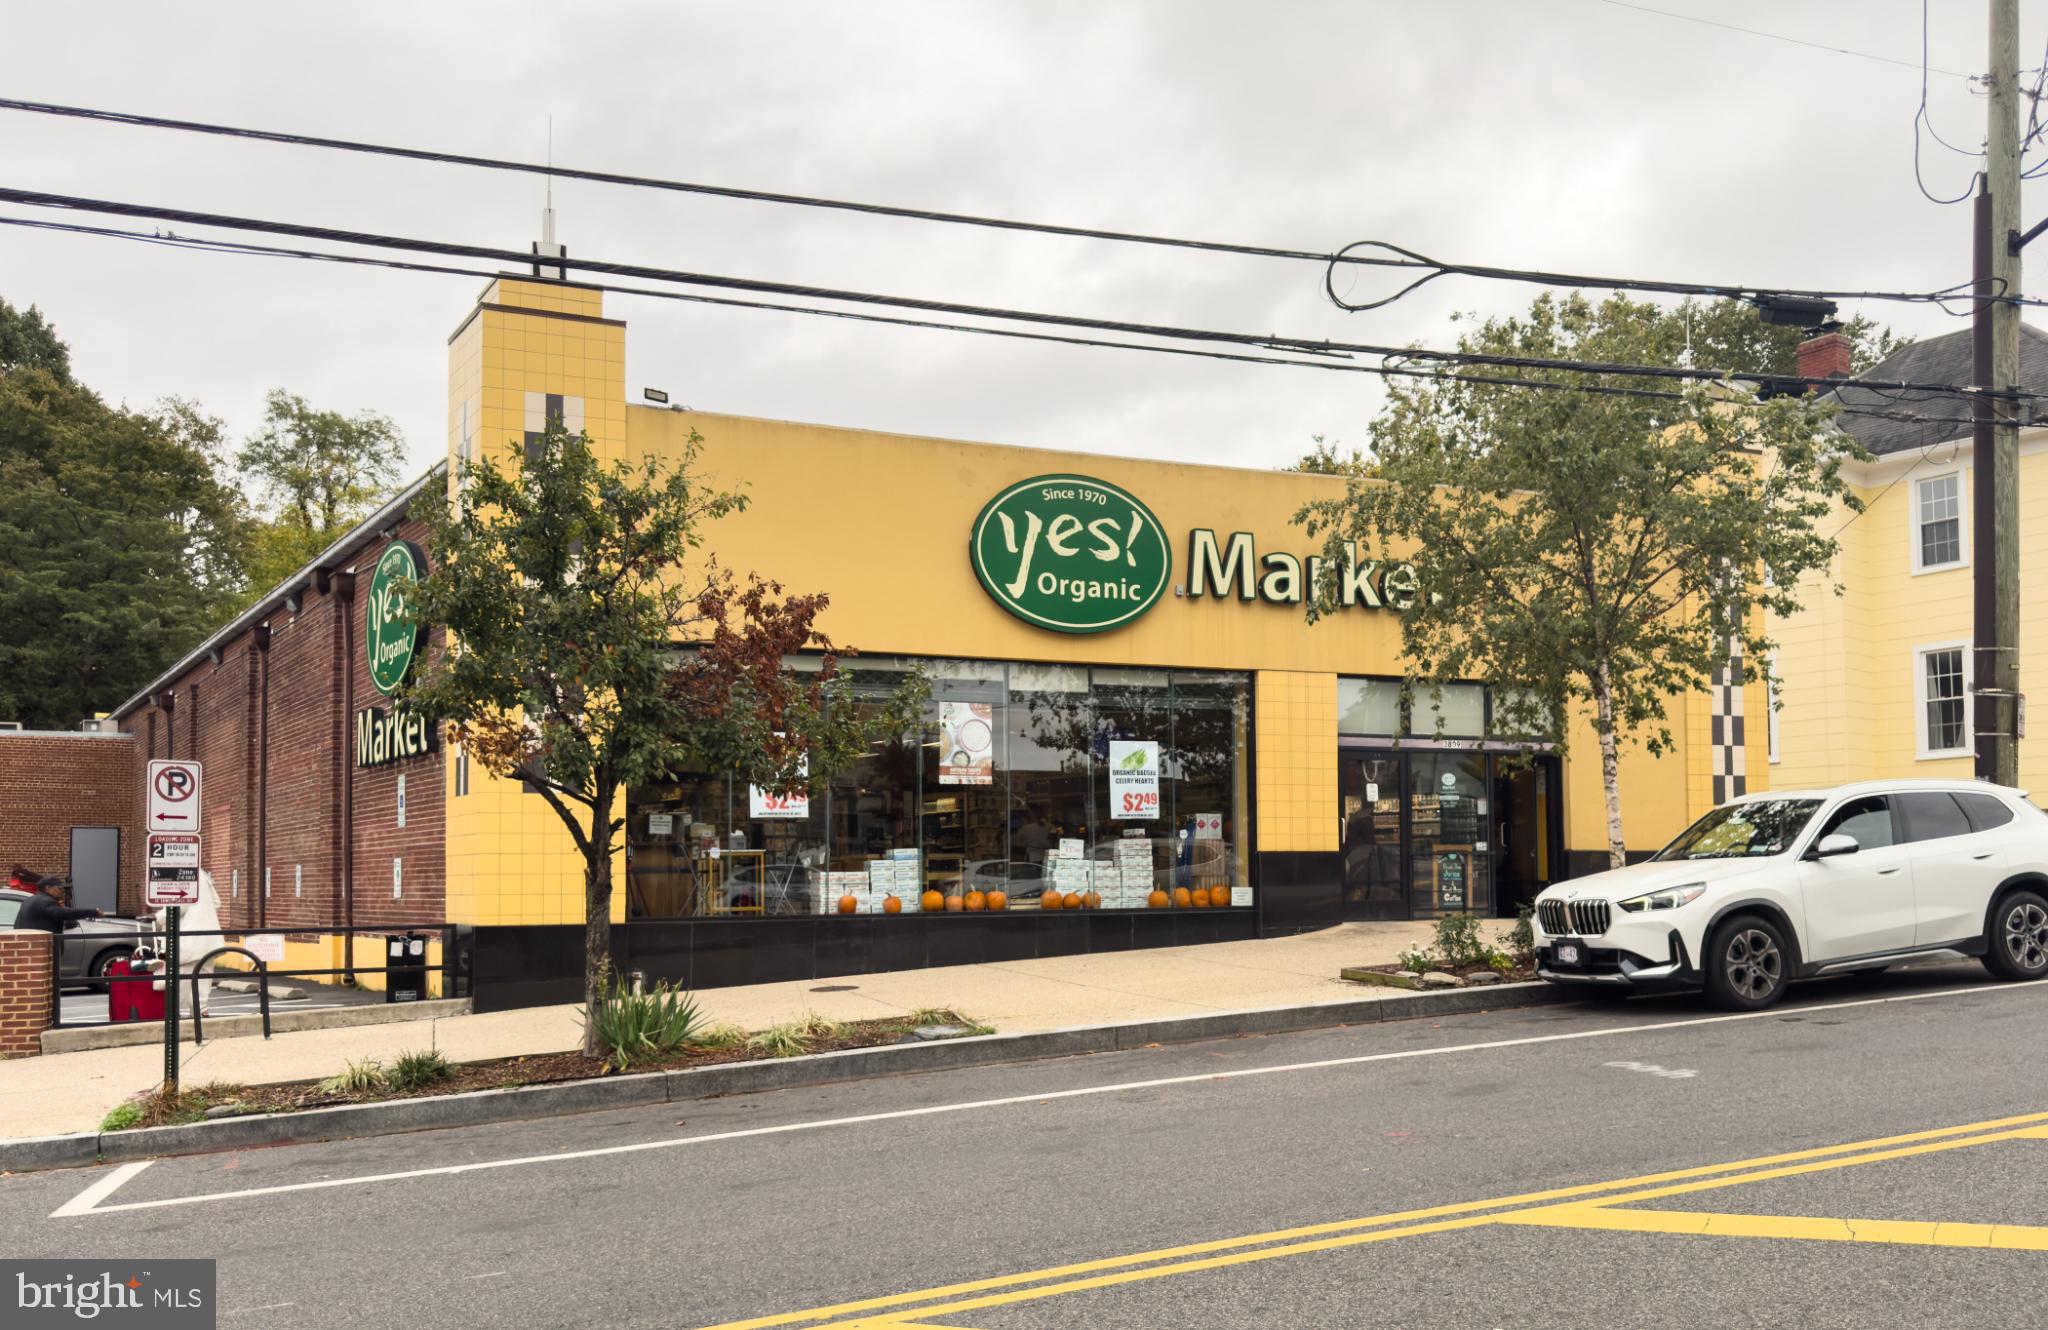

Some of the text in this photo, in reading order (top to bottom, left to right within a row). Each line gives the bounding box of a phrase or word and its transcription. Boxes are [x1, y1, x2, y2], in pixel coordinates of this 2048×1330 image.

[1042, 488, 1107, 506] Since 1970
[1187, 528, 1442, 610] Marke
[1037, 572, 1141, 603] Organic
[380, 634, 410, 666] Organic
[1135, 777, 1155, 785] HEARTS
[152, 843, 163, 857] 2
